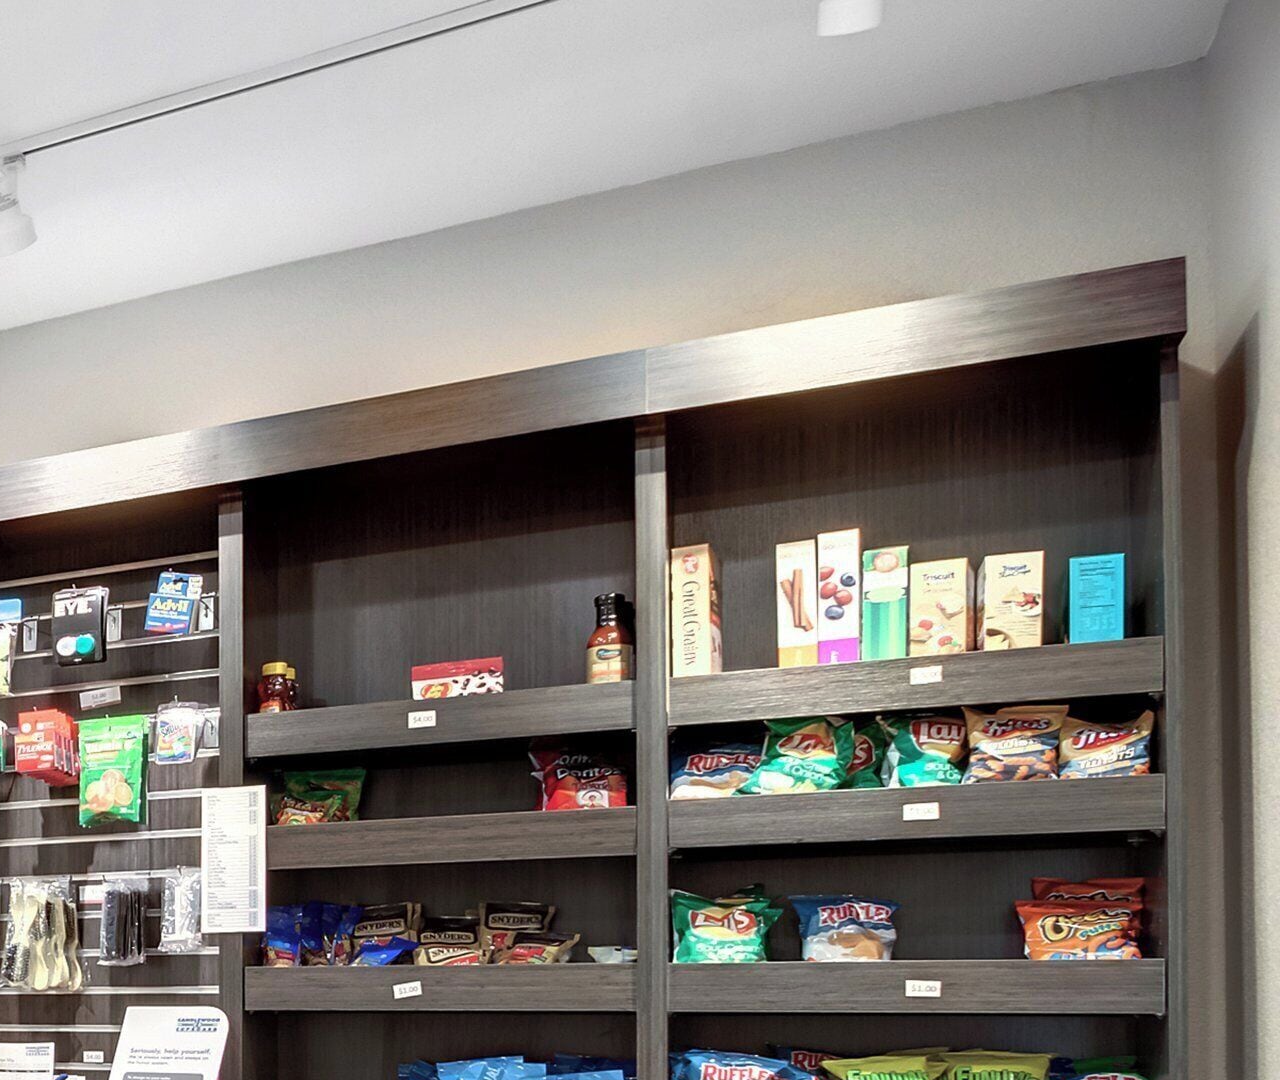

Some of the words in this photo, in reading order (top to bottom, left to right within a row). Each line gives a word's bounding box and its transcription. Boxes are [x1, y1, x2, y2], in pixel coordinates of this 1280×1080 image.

[922, 572, 955, 581] Triscuit
[151, 598, 189, 612] Advil
[398, 986, 418, 995] $1.00
[911, 984, 937, 993] $1.00
